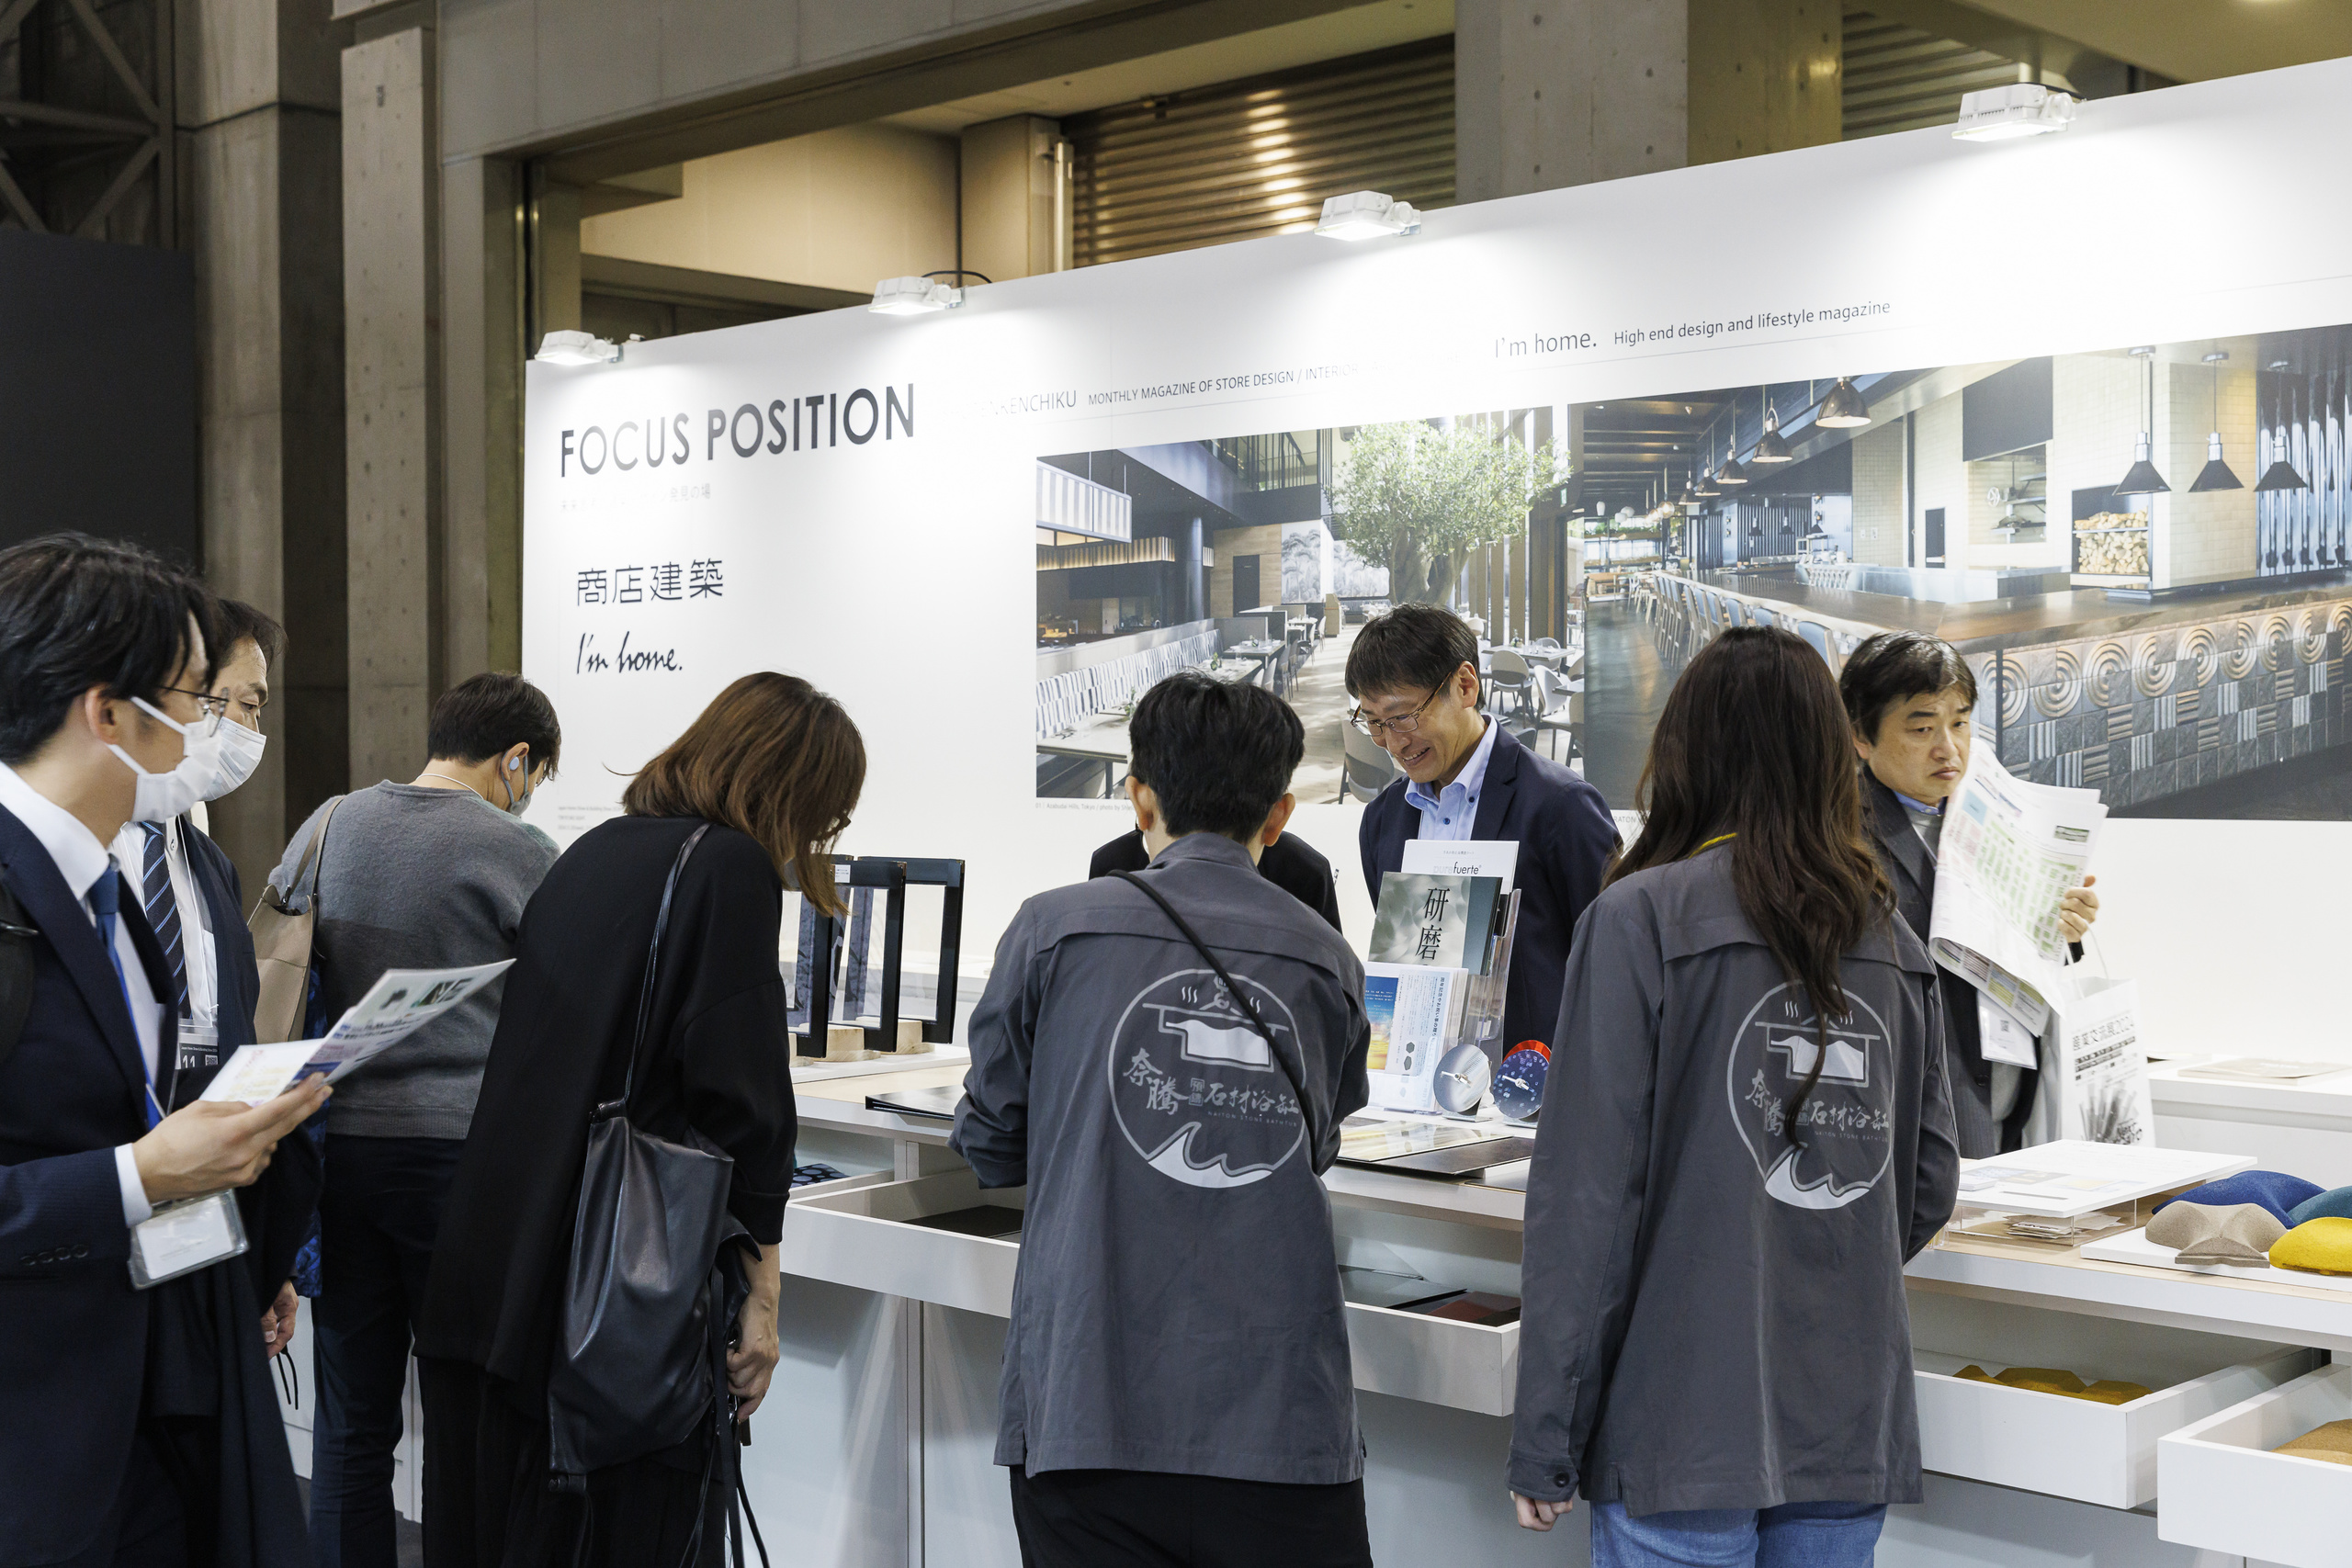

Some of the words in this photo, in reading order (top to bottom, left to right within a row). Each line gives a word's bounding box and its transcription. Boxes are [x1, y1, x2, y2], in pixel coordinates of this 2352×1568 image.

[1534, 330, 1598, 355] home.
[1613, 329, 1645, 347] High
[1648, 325, 1675, 341] end
[1678, 319, 1724, 339] design
[1727, 316, 1754, 333] and
[1758, 308, 1815, 331] lifestyle
[1818, 300, 1891, 324] magazine
[1088, 389, 1138, 405] MONTHLY
[1140, 381, 1196, 399] MAGAZINE
[1198, 379, 1213, 393] OF
[1216, 375, 1250, 391] STORE
[1253, 370, 1295, 387] DESIGN
[1306, 362, 1359, 381] INTERIOR
[560, 412, 691, 478] FOCUS
[707, 382, 916, 461] POSITION
[576, 558, 724, 606] 商店建築
[616, 630, 684, 674] home.
[1415, 886, 1451, 966] 研磨
[1239, 1114, 1263, 1122] STONE
